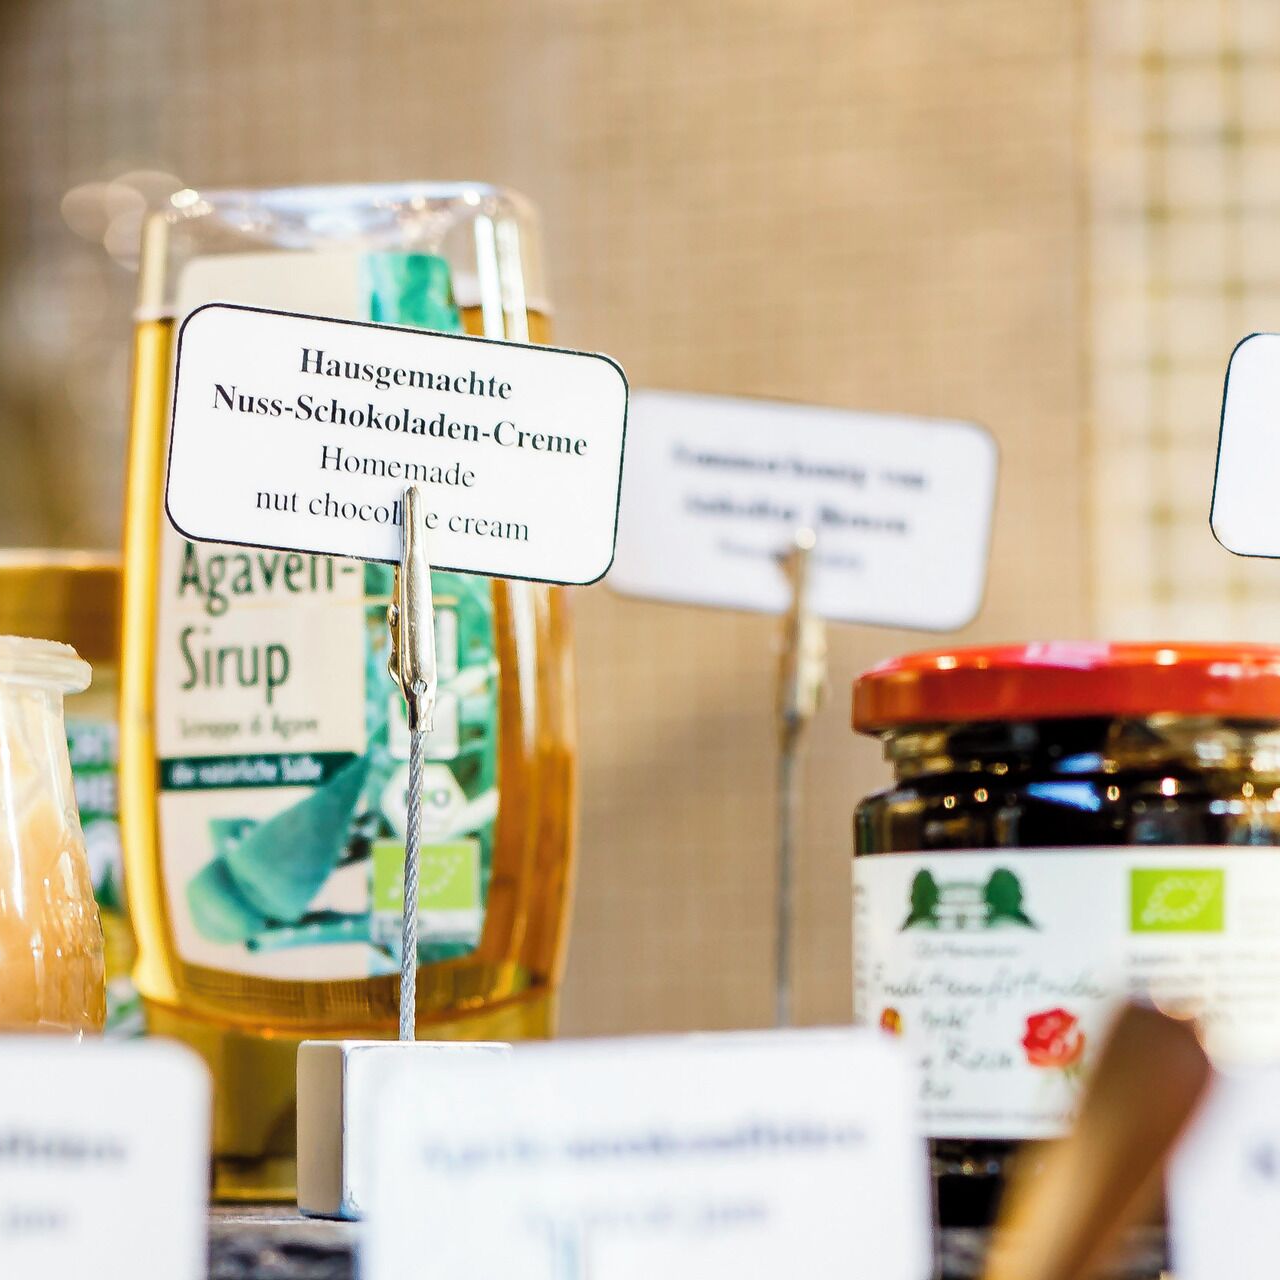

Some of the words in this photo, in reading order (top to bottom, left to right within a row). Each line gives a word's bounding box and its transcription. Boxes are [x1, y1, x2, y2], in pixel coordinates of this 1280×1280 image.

[299, 347, 513, 399] Hausgemachte
[213, 384, 588, 456] Nuss-Schokoladen-Creme
[321, 446, 475, 487] Homemade
[256, 491, 298, 513] nut
[309, 493, 439, 529] chocole
[449, 514, 529, 541] cream
[177, 541, 356, 617] Agaven-
[178, 625, 291, 705] Sirup
